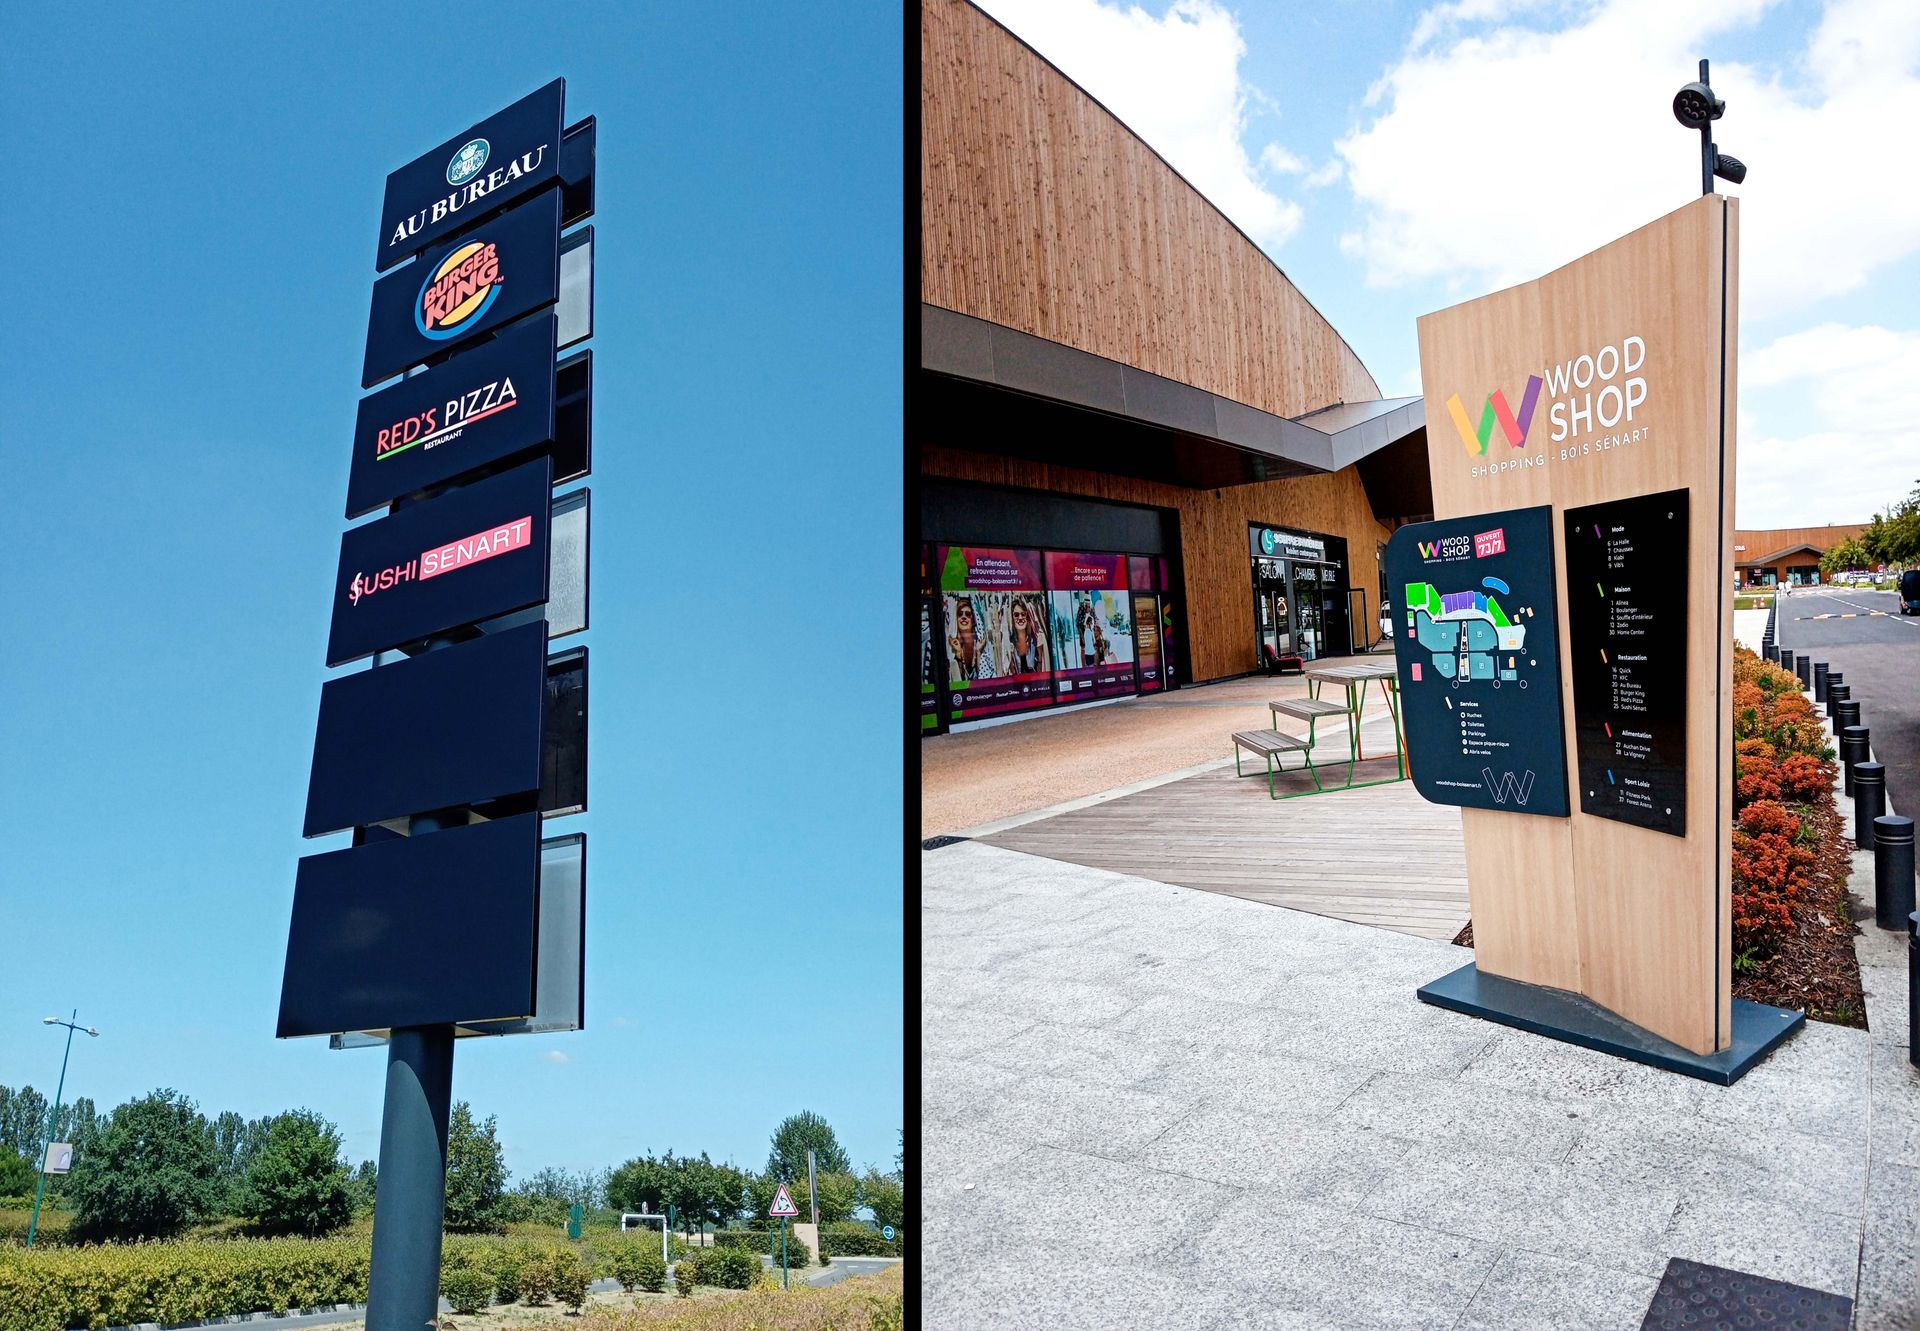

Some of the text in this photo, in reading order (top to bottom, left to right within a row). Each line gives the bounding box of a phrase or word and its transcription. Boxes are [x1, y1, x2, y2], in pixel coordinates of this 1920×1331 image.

[389, 145, 547, 246] AU BUREAU
[424, 243, 496, 310] BURGER
[425, 257, 499, 331] KING
[1544, 336, 1646, 398] WOOD
[377, 377, 517, 454] RED'S PIZZA
[1550, 377, 1647, 442] SHOP
[424, 429, 463, 450] RESTAURANT
[1472, 454, 1545, 478] SHOPPING
[1561, 442, 1589, 461] BOIS
[1596, 427, 1649, 452] SÉNART
[1441, 536, 1469, 547] WOOD
[1442, 545, 1470, 557] SHOP
[1476, 532, 1501, 543] OUVERT
[1478, 540, 1502, 556] 7J/7
[349, 522, 527, 606] SUSHI SENART
[970, 567, 1010, 575] retrouvez-nous
[985, 560, 1011, 568] attendant,
[1622, 730, 1652, 739] Alimentation
